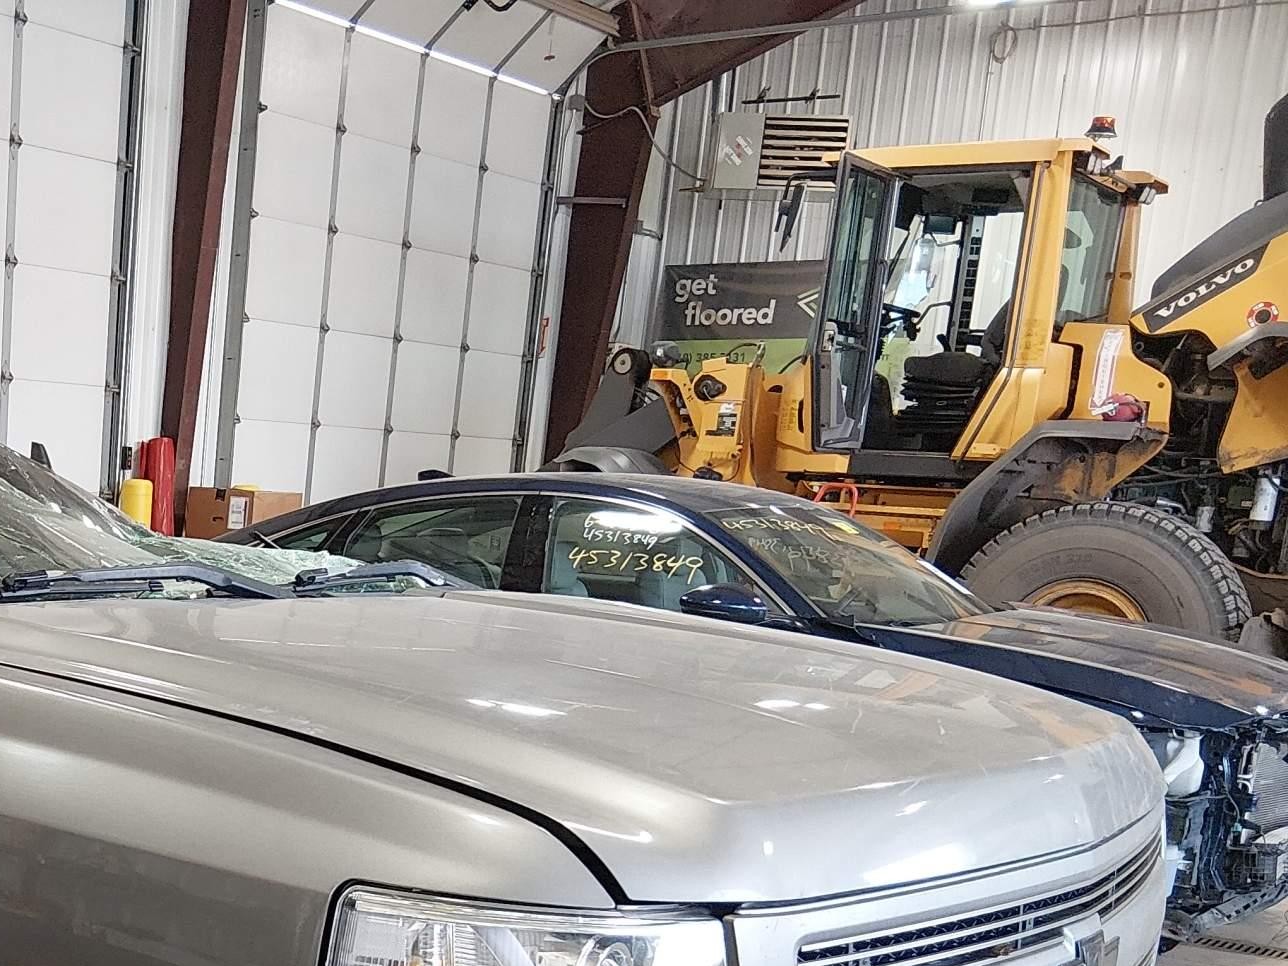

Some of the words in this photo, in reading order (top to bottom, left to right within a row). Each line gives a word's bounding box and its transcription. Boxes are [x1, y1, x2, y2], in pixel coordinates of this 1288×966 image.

[674, 273, 718, 303] get
[1153, 258, 1255, 318] VOLVO
[685, 298, 777, 327] floored
[583, 527, 658, 550] 45313849
[568, 547, 704, 585] 45313849
